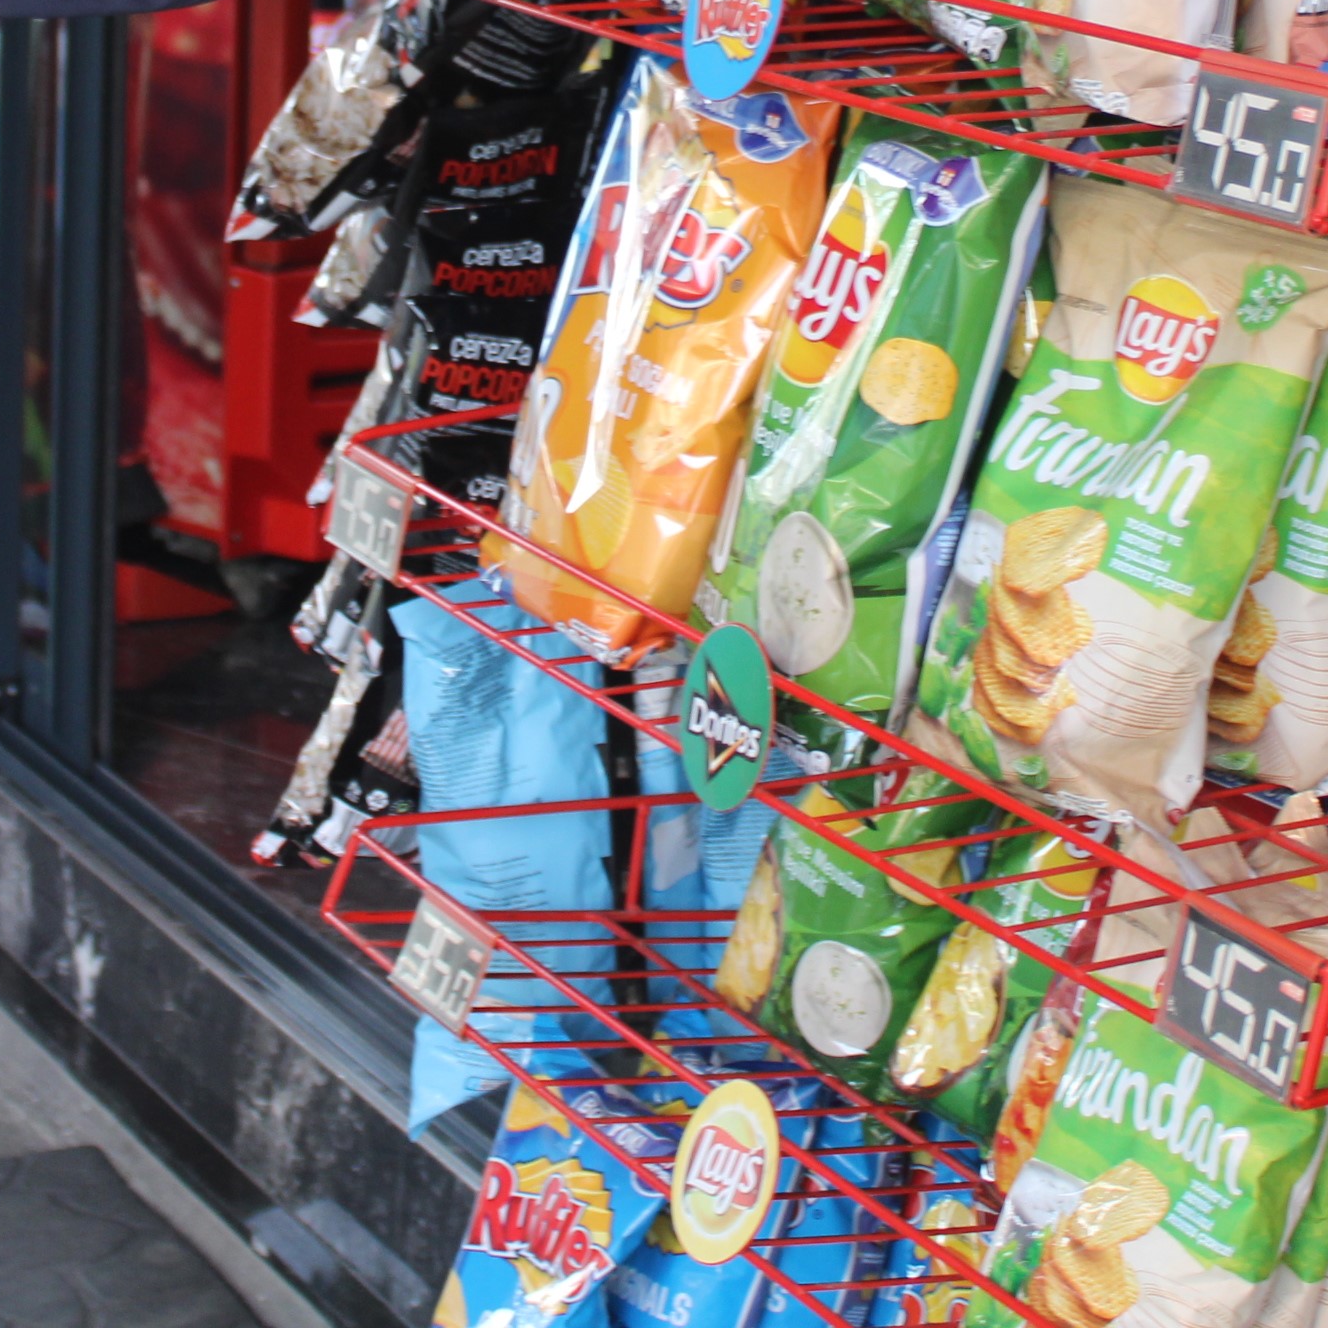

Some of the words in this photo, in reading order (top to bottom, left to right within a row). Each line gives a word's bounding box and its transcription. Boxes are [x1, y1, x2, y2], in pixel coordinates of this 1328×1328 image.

[1192, 85, 1312, 213] 45.0
[1115, 297, 1217, 377] Lay's
[688, 698, 762, 758] Doritos
[1183, 922, 1297, 1088] 45.0
[686, 1127, 764, 1216] Lay's
